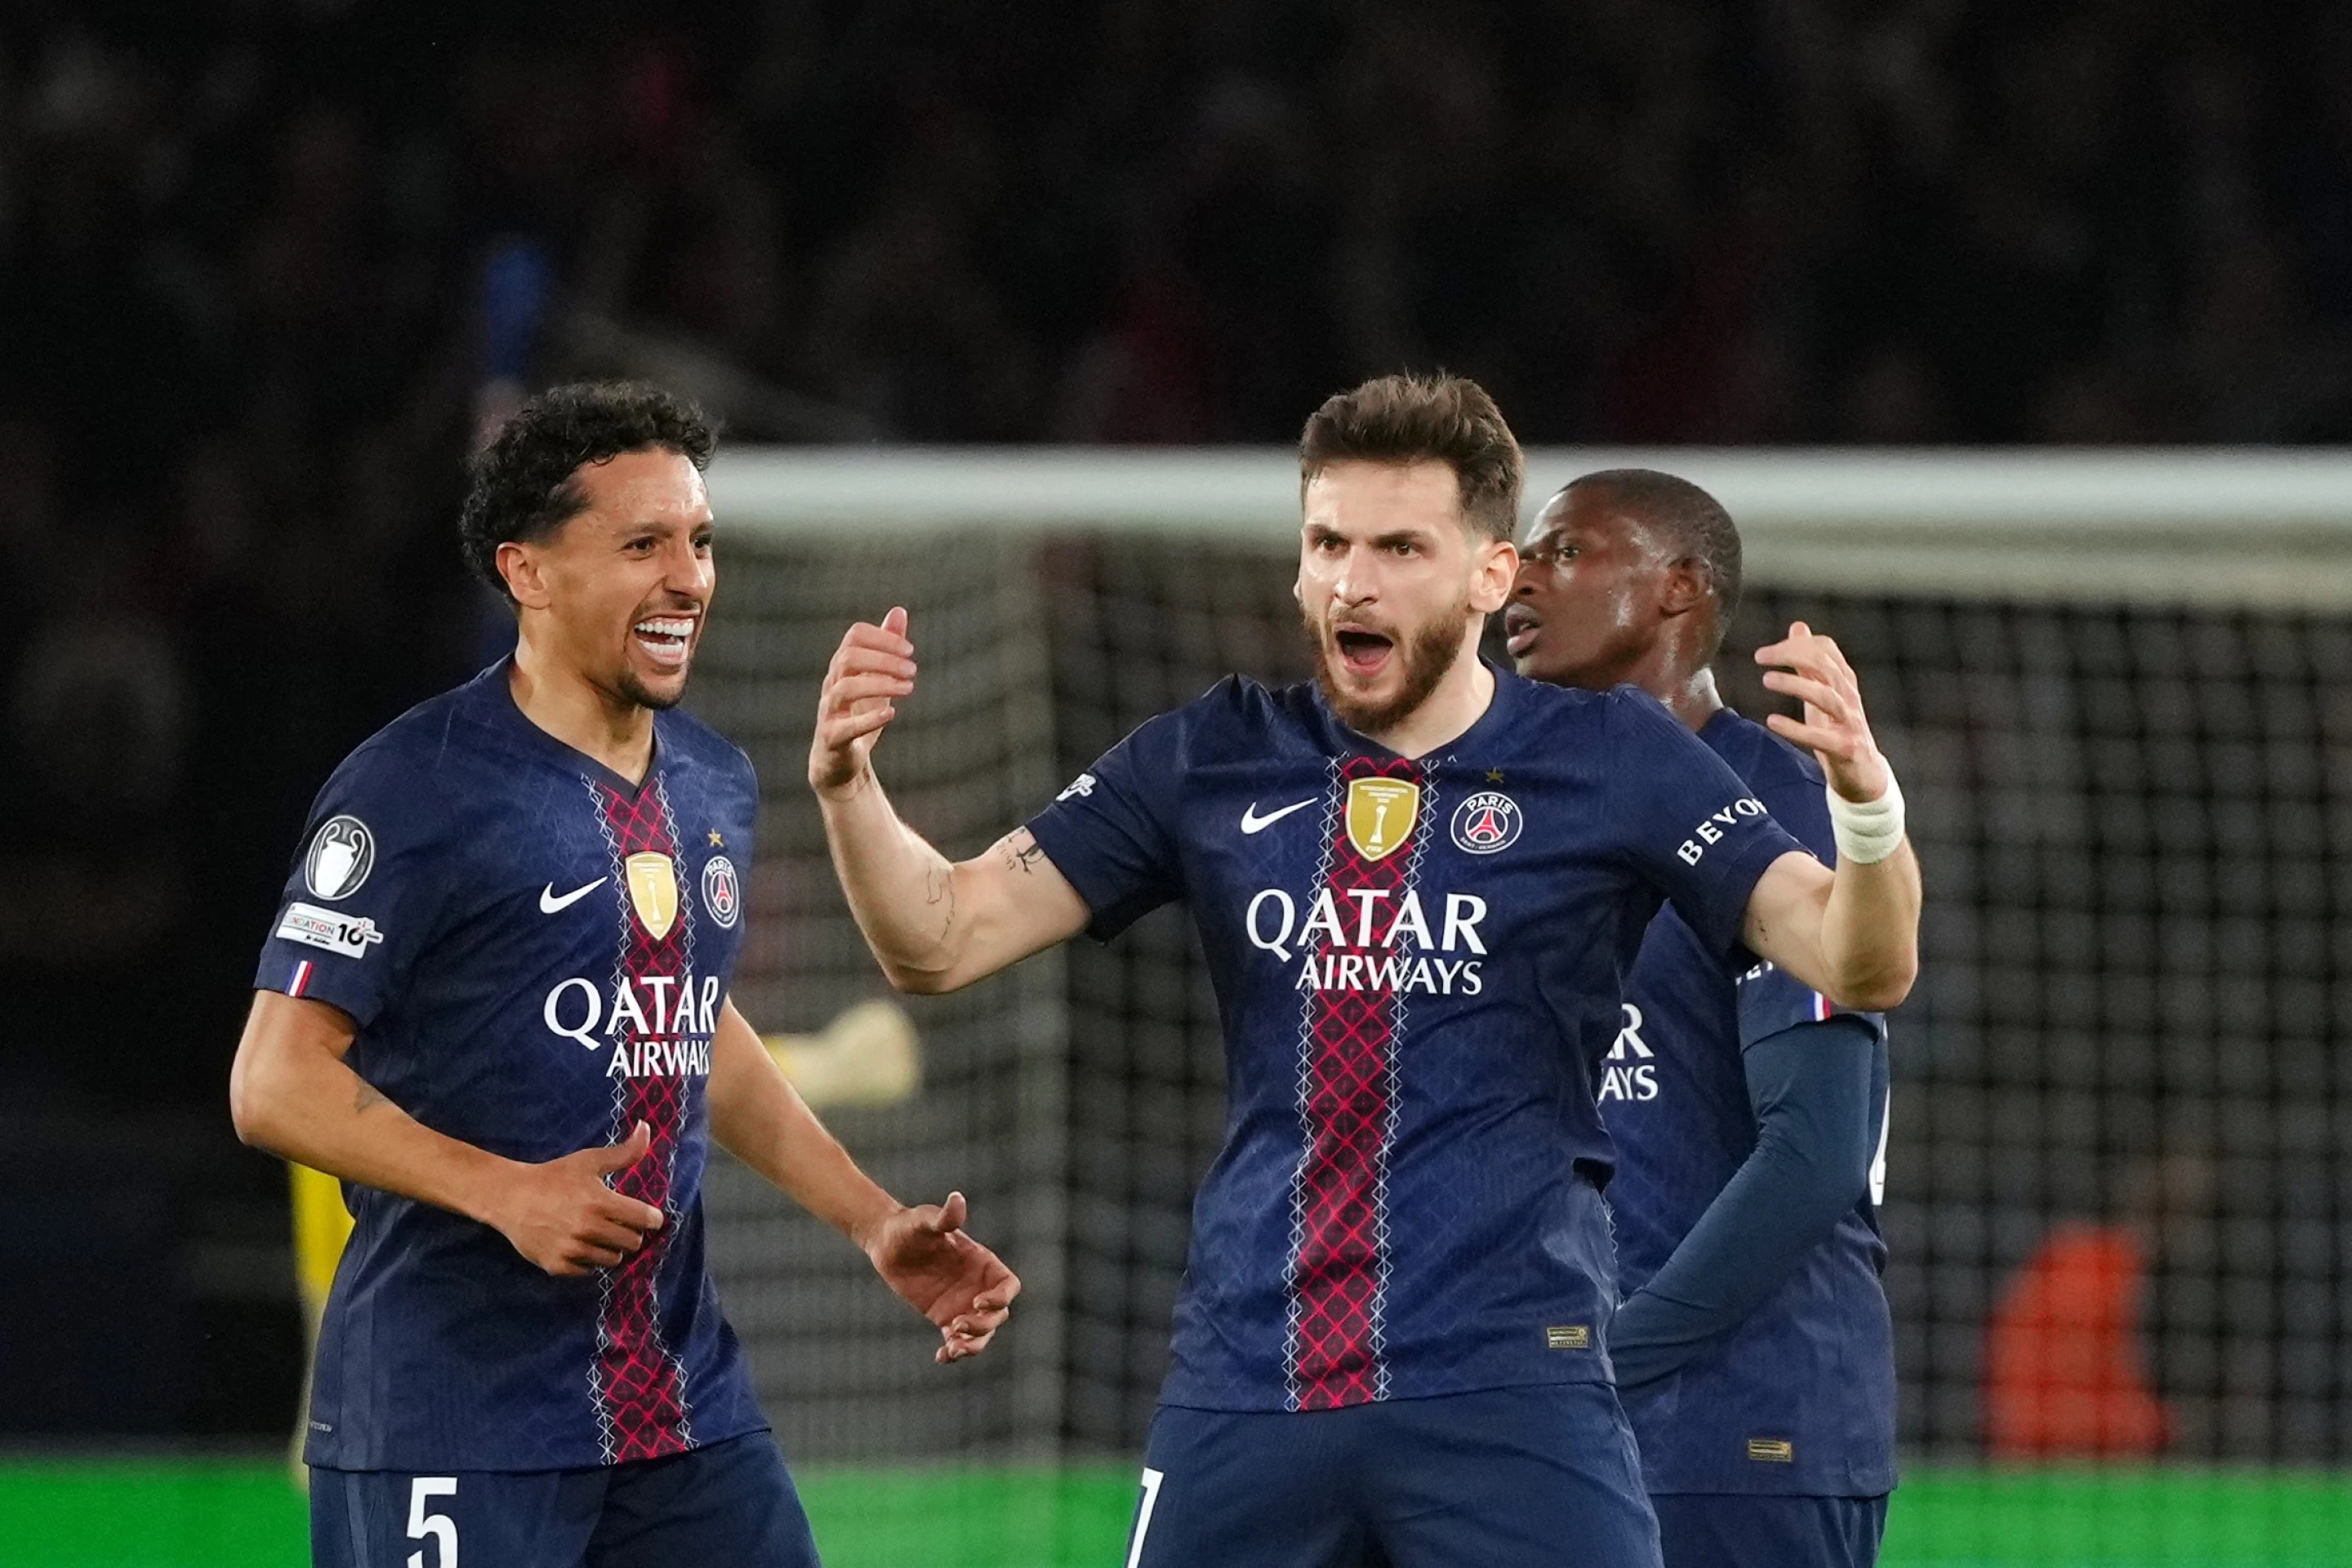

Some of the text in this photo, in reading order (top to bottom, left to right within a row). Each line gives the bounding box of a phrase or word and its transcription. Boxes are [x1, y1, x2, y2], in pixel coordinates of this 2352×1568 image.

[1467, 795, 1513, 814] PARIS
[706, 860, 733, 878] PARIS
[1246, 887, 1488, 963] QATAR
[1295, 954, 1483, 995] AIRWAYS
[544, 975, 719, 1051] QATAR
[407, 1477, 459, 1568] 5
